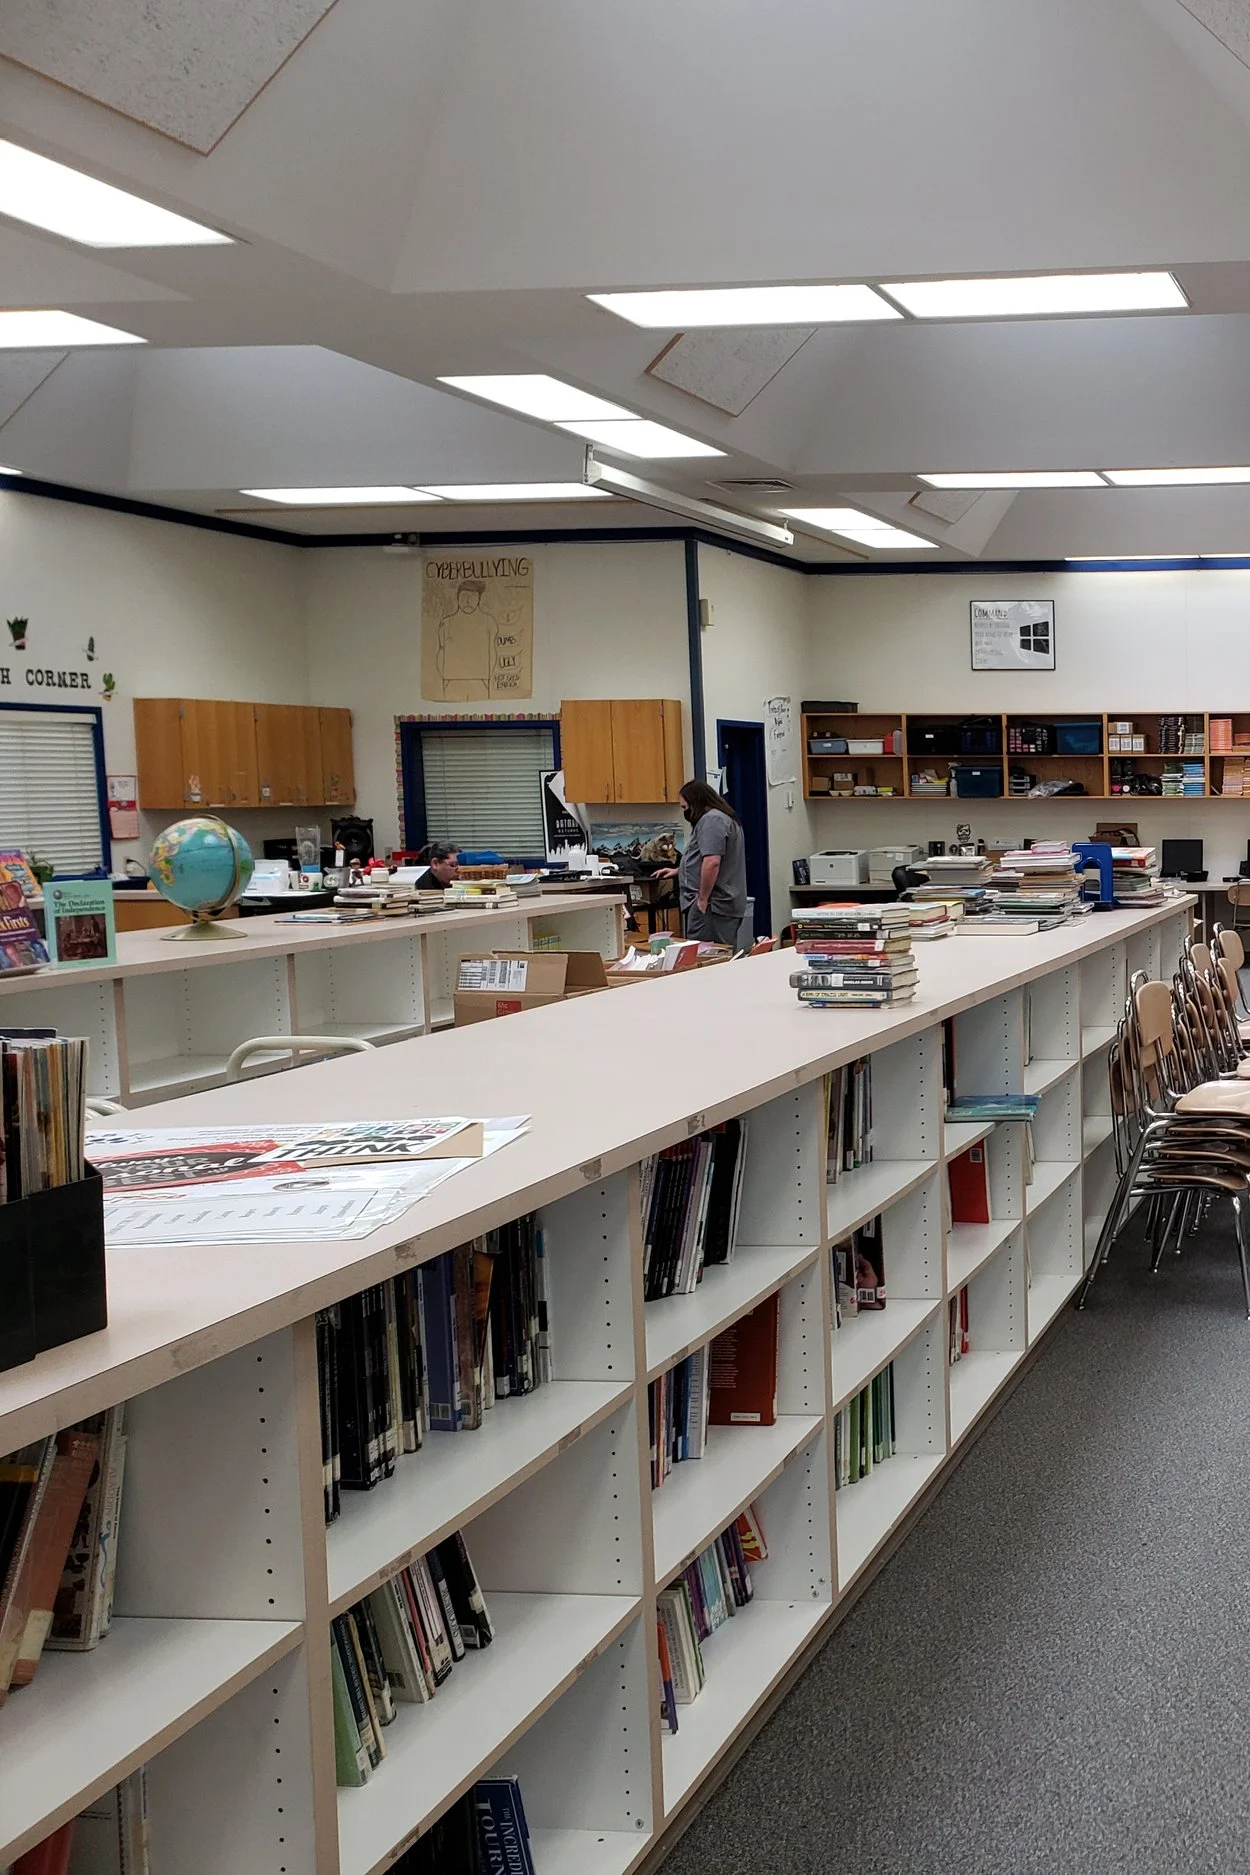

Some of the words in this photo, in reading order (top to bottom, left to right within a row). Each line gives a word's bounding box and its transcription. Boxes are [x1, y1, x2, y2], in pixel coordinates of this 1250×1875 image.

[426, 557, 529, 580] CYBERBULLYING
[499, 656, 516, 669] UGLY
[25, 669, 91, 689] CORNER
[801, 974, 832, 987] SHAD
[274, 1142, 427, 1160] THINK
[114, 1157, 211, 1173] YOUR
[502, 1808, 512, 1820] THE
